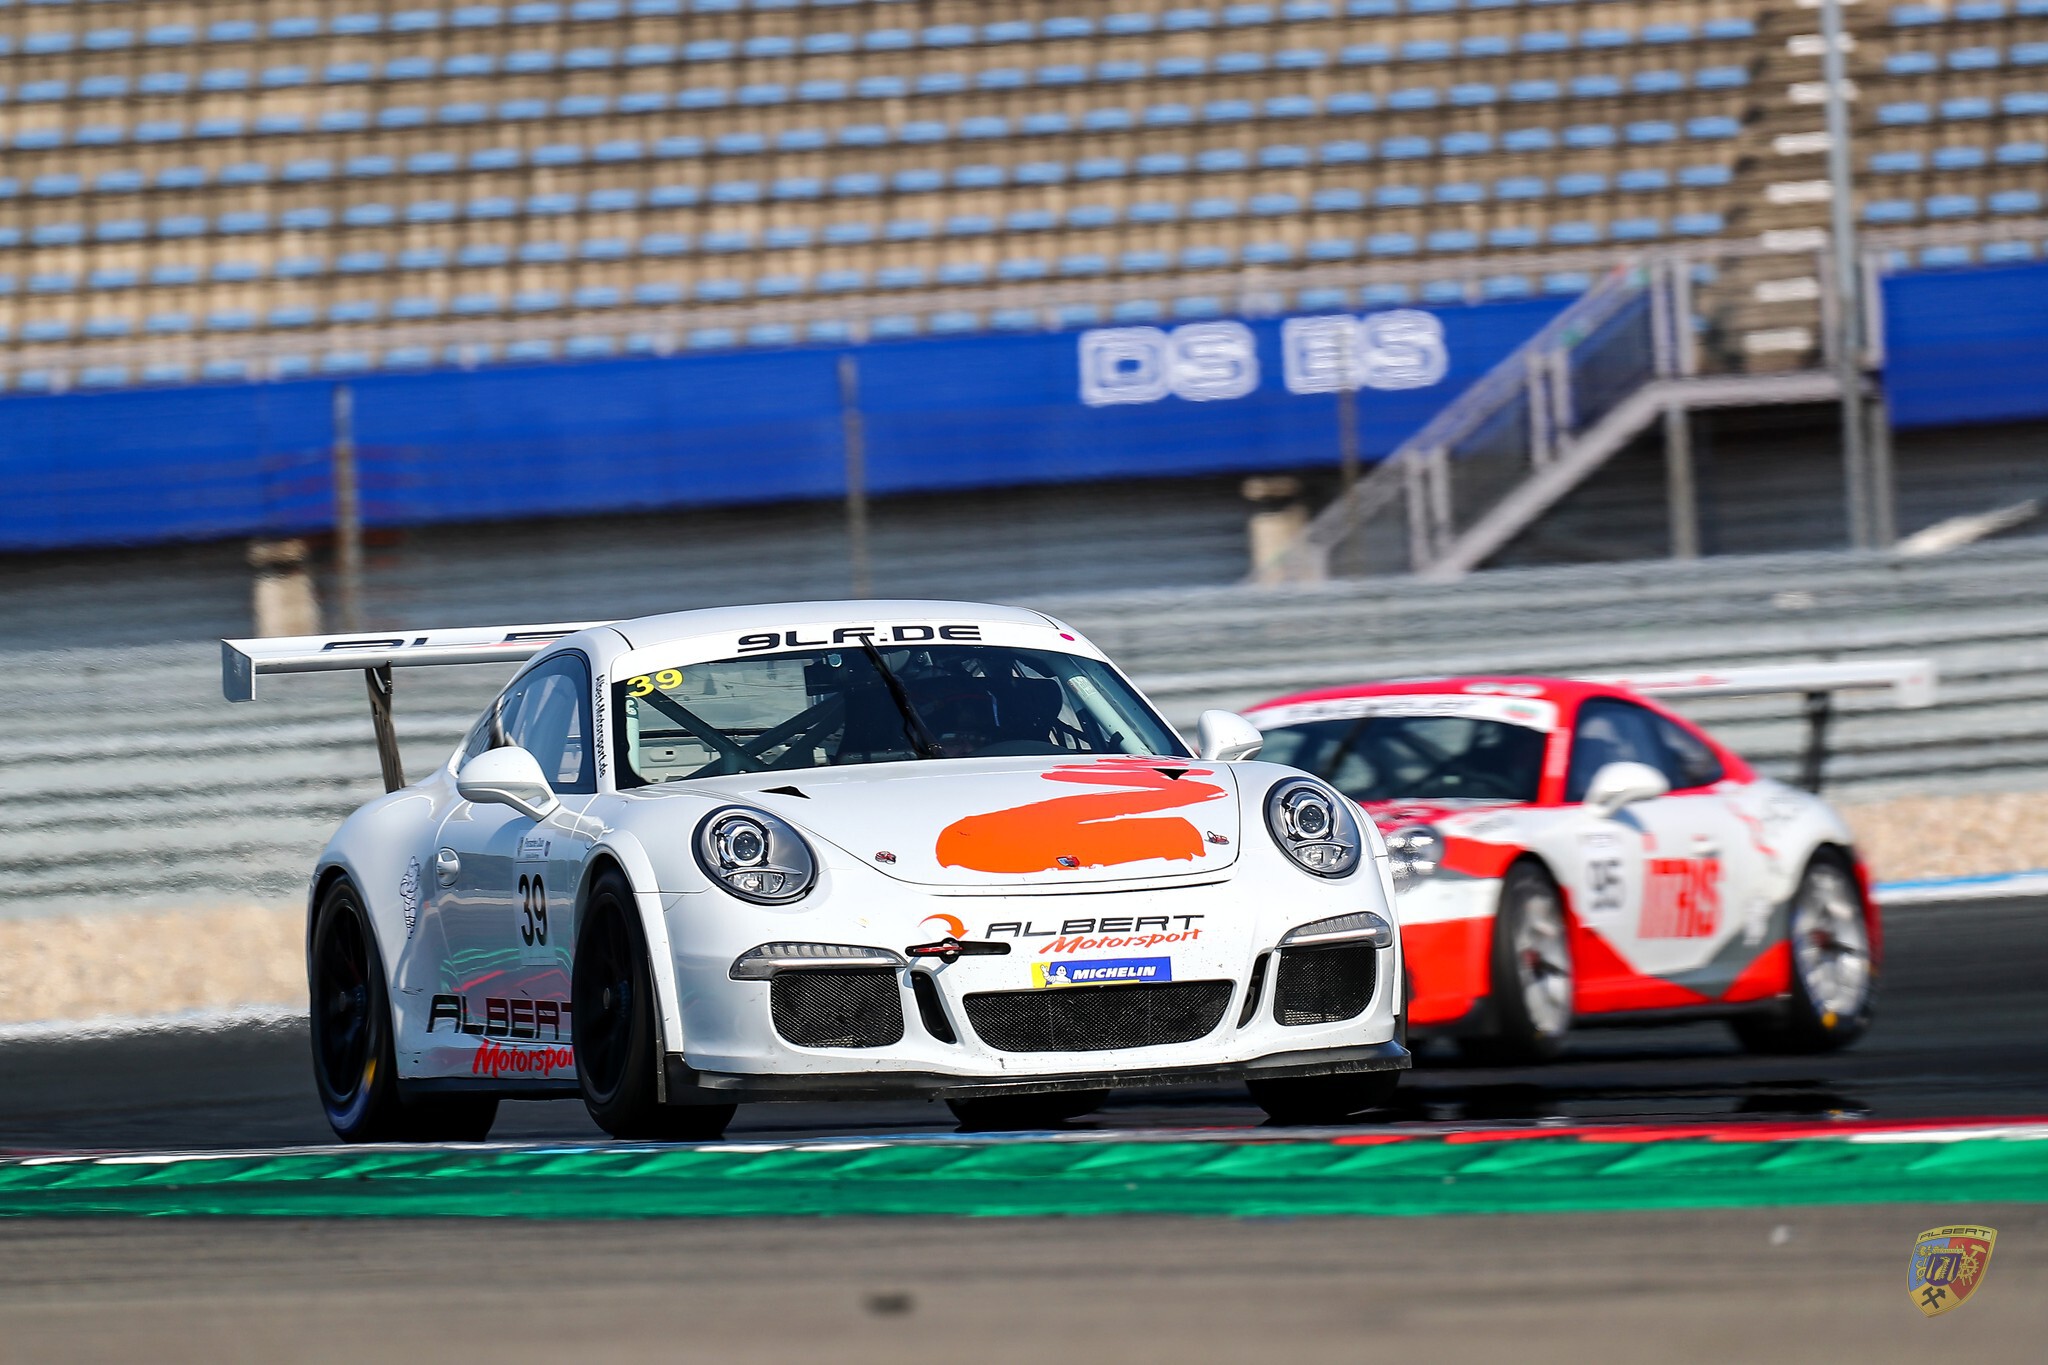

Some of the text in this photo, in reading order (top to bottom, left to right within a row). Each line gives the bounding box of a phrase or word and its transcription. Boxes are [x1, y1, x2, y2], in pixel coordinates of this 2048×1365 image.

[1078, 322, 1260, 407] DS
[626, 668, 684, 697] 39
[518, 873, 548, 947] 39
[984, 914, 1205, 939] ALBERT
[1038, 928, 1204, 955] Motorsport
[1072, 964, 1158, 980] MICHELIN
